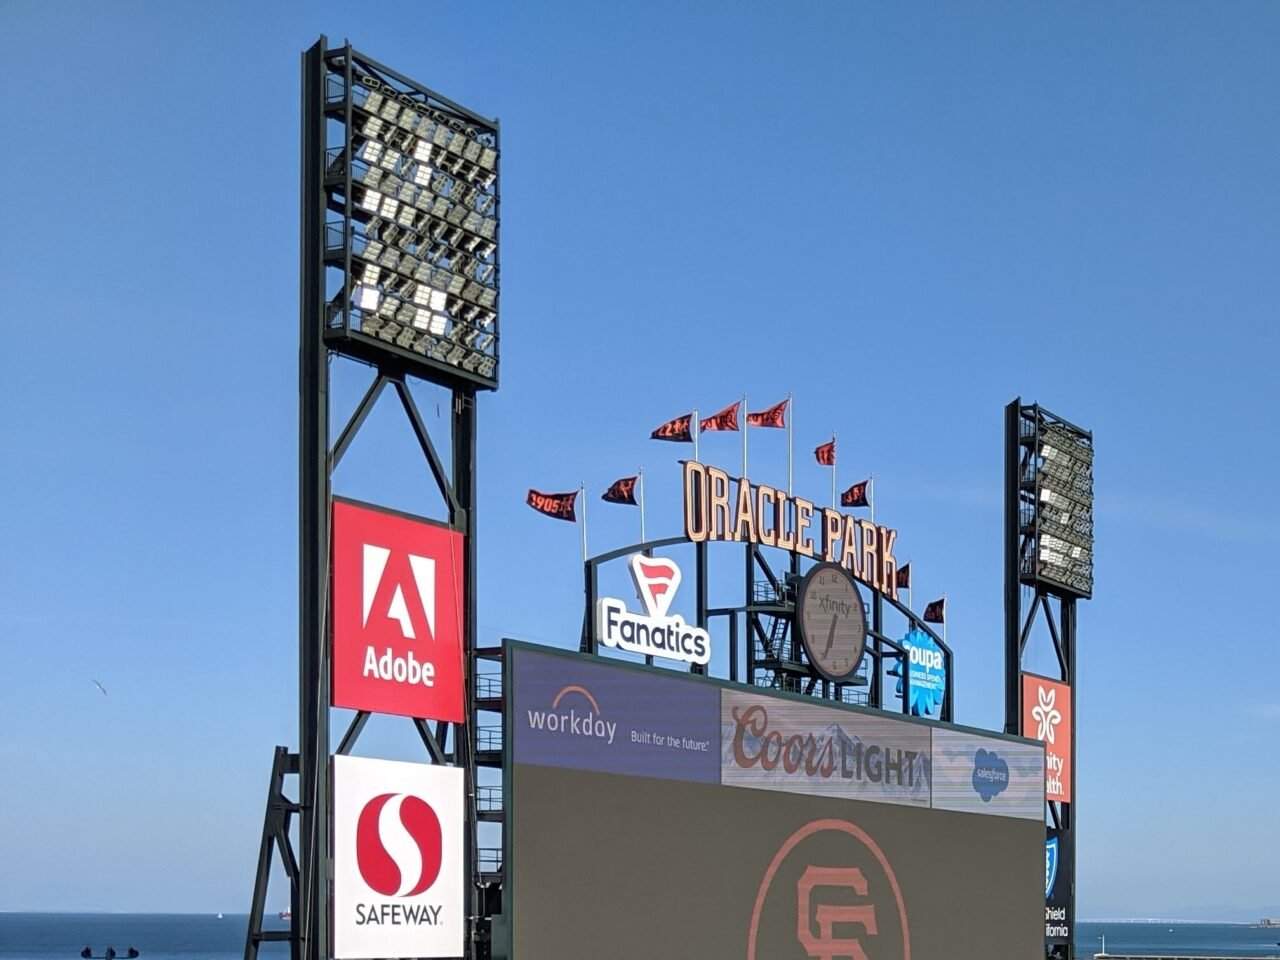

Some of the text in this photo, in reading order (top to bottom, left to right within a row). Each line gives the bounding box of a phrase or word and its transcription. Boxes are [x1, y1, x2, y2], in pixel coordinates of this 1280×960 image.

[684, 460, 899, 602] ORACLE PARK
[607, 605, 706, 657] Fanatics
[363, 645, 435, 687] Adobe
[902, 640, 943, 674] oupa
[527, 709, 617, 745] workday
[631, 730, 651, 744] Built
[652, 733, 665, 746] for
[667, 736, 680, 749] the
[731, 705, 920, 788] Coors LIGHT
[355, 903, 443, 926] SAFEWAY
